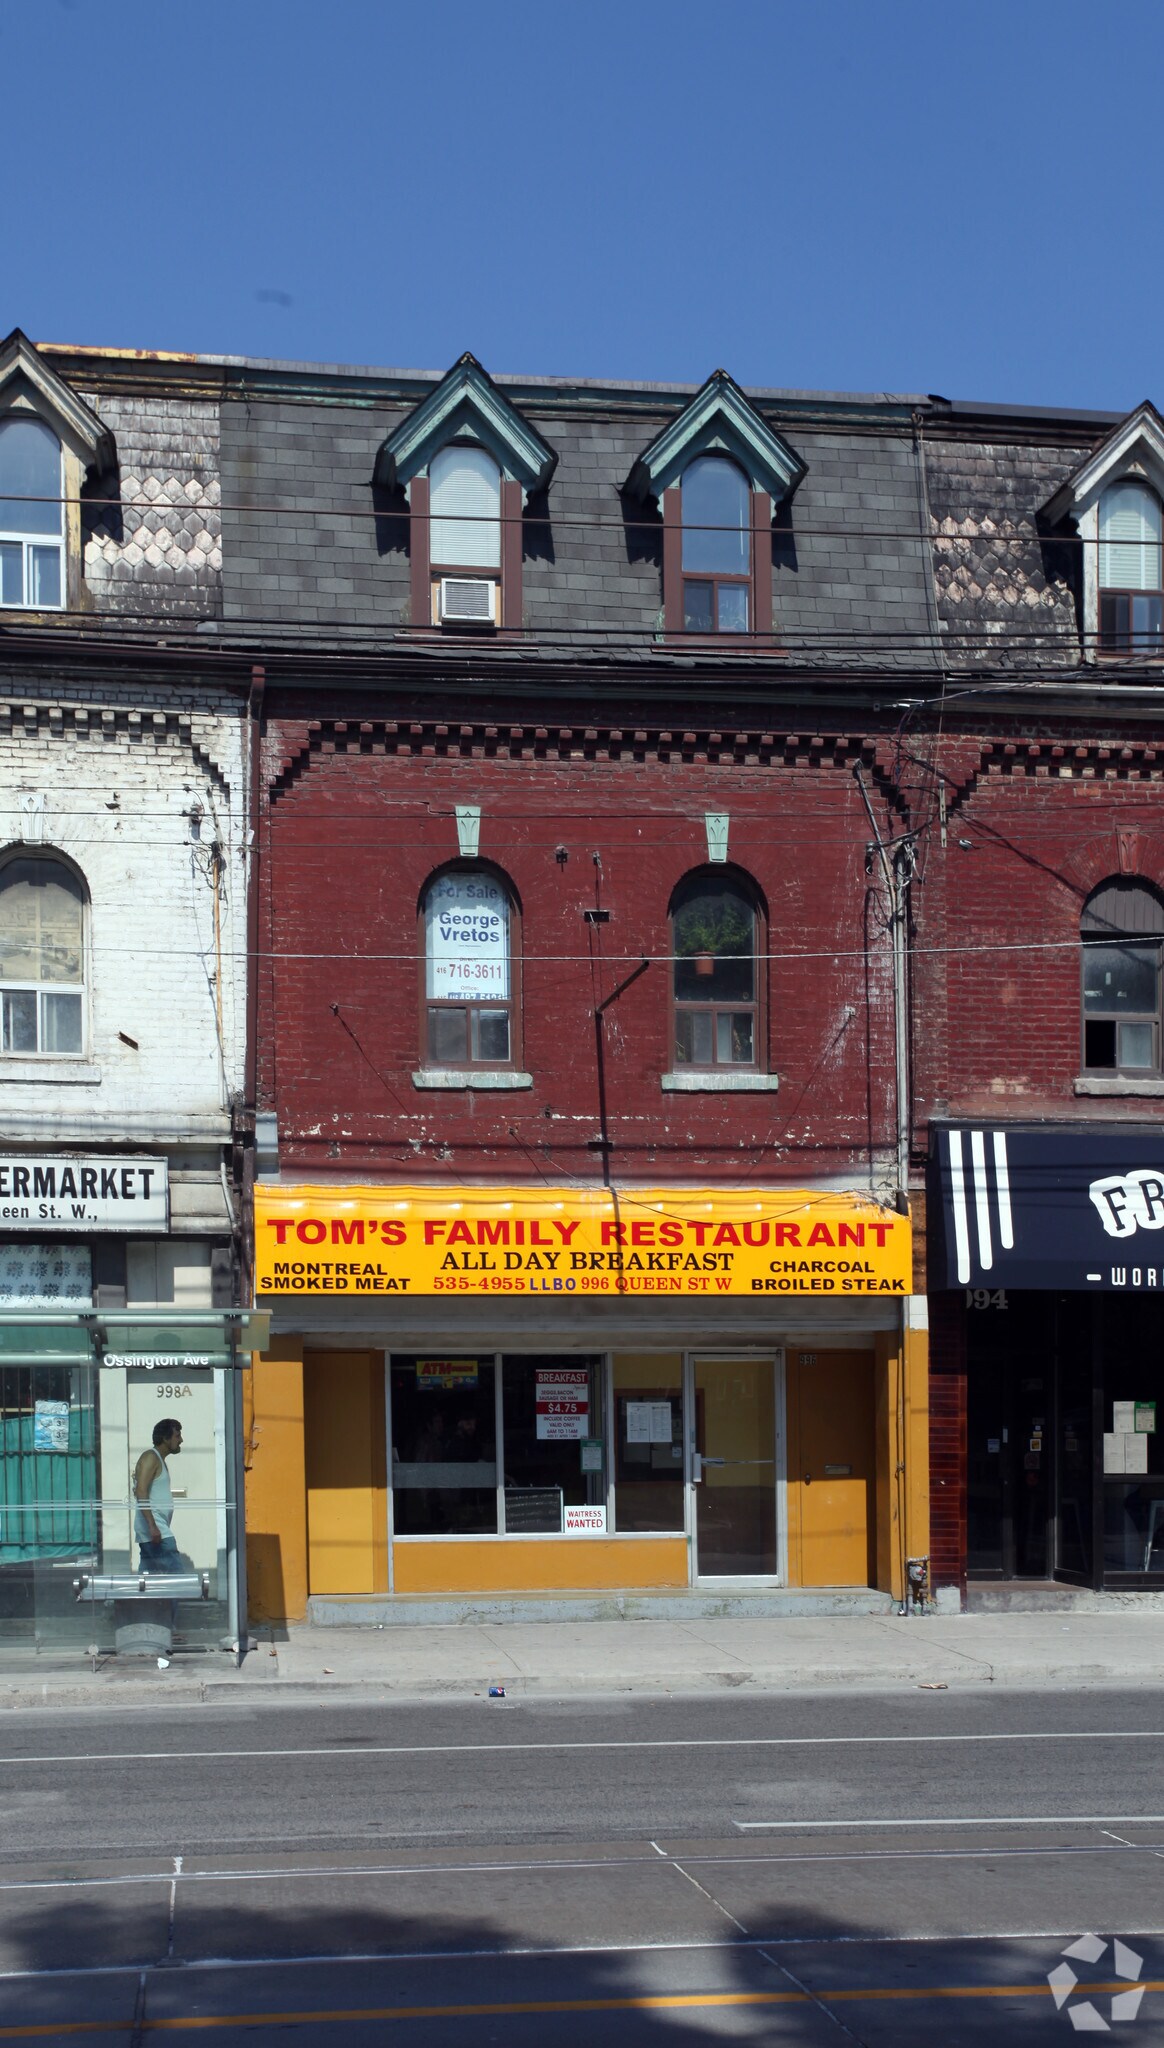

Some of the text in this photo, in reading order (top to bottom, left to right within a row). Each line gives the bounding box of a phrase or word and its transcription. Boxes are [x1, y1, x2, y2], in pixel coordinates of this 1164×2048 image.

[438, 885, 498, 898] For Sale
[439, 911, 500, 928] George
[440, 927, 500, 942] Vretos
[436, 963, 502, 979] 416 716-3611
[0, 1166, 155, 1200] ERMARKET
[2, 1203, 98, 1222] een St. W.,
[267, 1219, 894, 1247] TOM'S FAMILY RESTAURANT
[440, 1252, 734, 1271] ALL DAY BREAKFAST
[769, 1261, 875, 1273] CHARCOAL
[273, 1263, 388, 1275] MONTREAL
[260, 1277, 411, 1290] SMOKED MEAT
[433, 1276, 526, 1290] 535-4955
[581, 1277, 609, 1290] 996
[615, 1277, 682, 1291] QUEEN
[687, 1277, 709, 1290] ST
[717, 1277, 732, 1290] W
[1111, 1267, 1164, 1287] WOR
[751, 1278, 905, 1291] BROILED STEAK
[103, 1353, 209, 1369] Ossington Ave
[421, 1362, 451, 1375] ATM
[538, 1373, 586, 1382] BREAKFAST
[157, 1385, 192, 1398] 998A
[548, 1402, 577, 1414] $4.75
[567, 1510, 602, 1518] WAITRESS
[566, 1519, 603, 1528] WANTED
